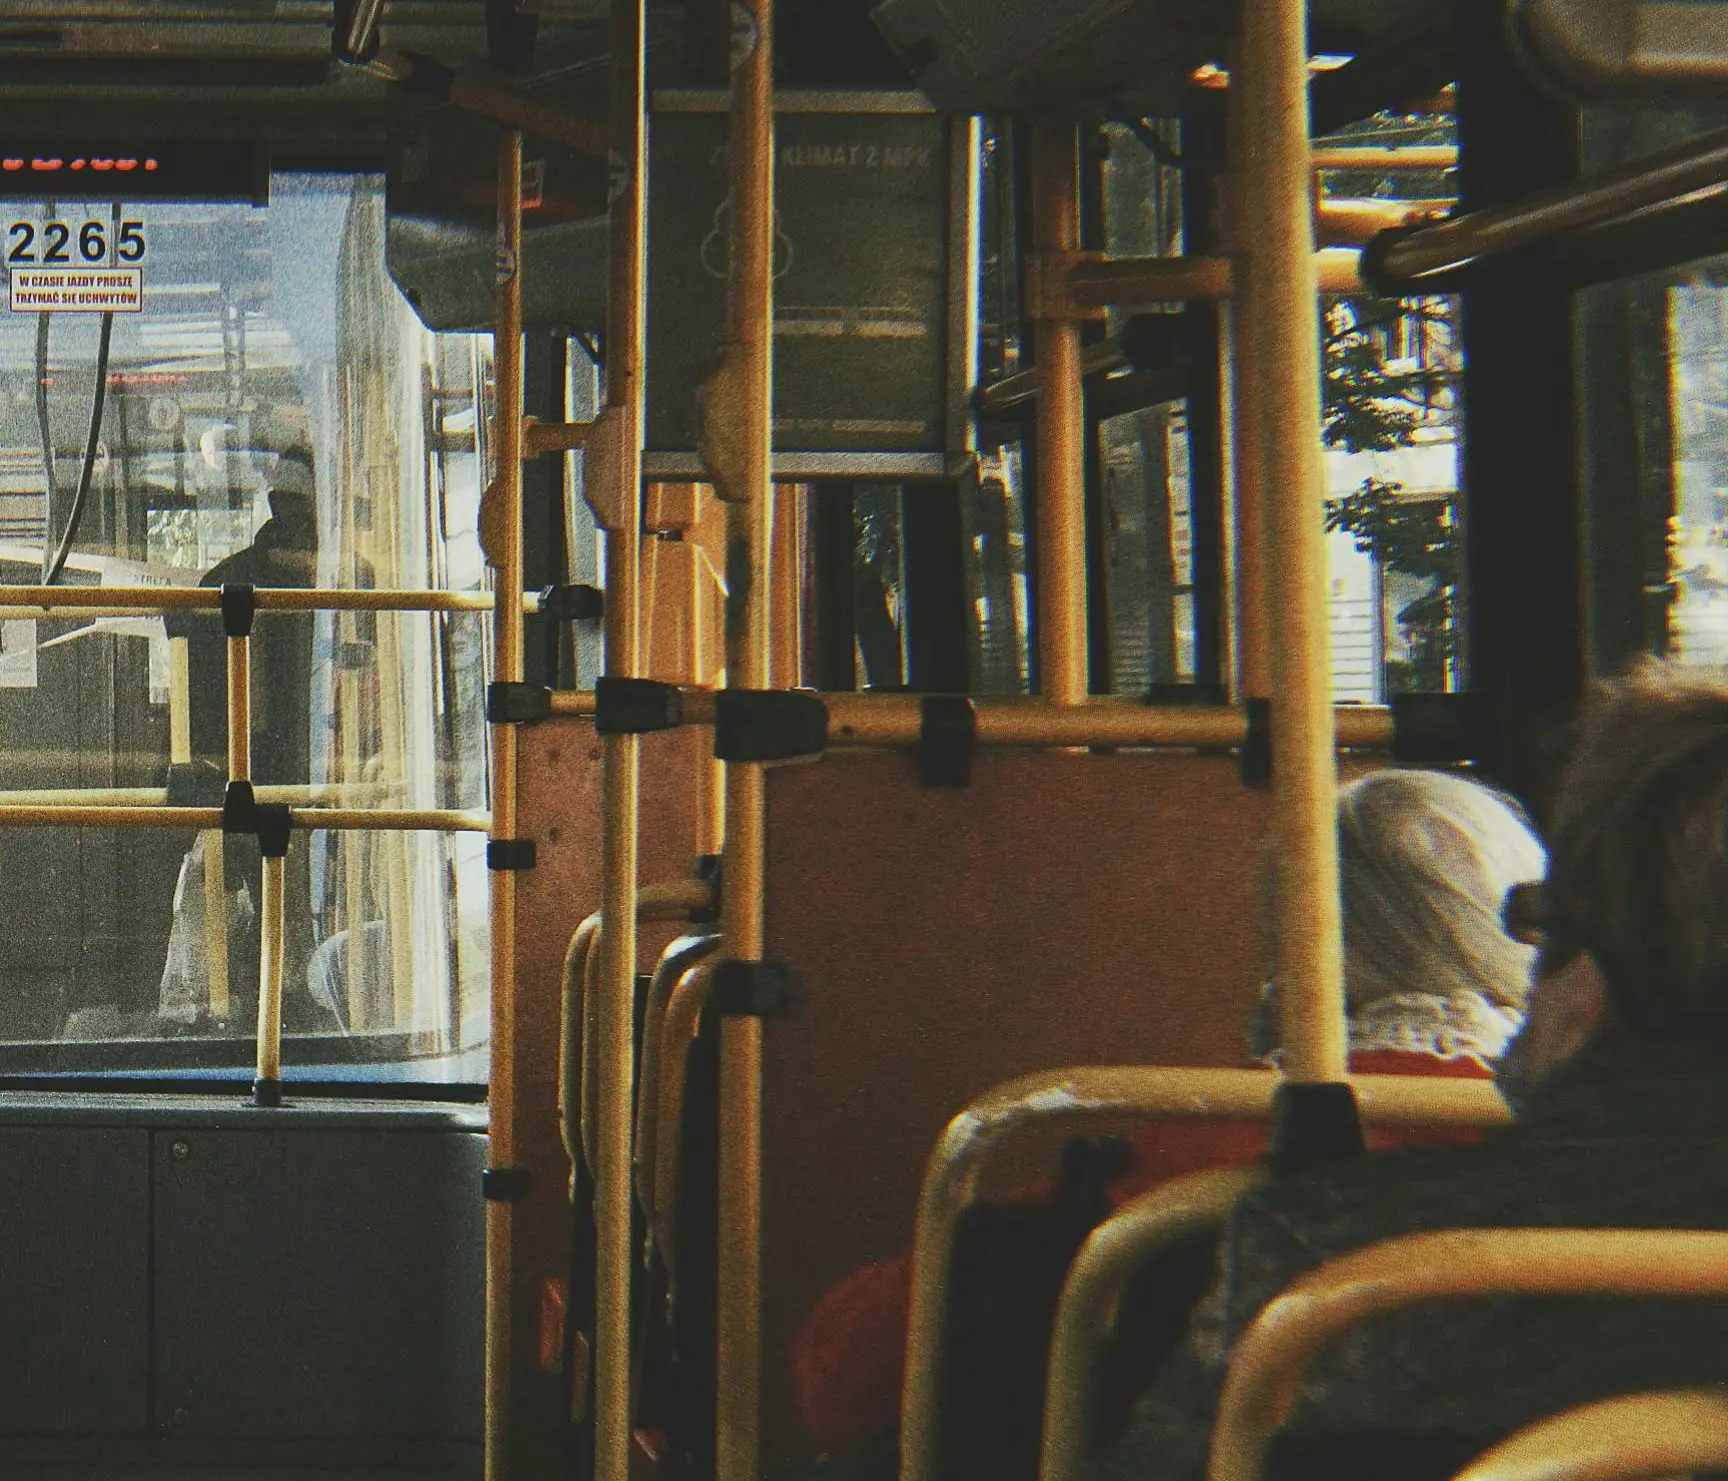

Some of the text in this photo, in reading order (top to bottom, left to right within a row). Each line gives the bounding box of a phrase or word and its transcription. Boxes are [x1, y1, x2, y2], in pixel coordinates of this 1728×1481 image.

[8, 220, 146, 263] 2265
[19, 276, 133, 289] W CZASIE JAZDY PROSZĘ
[15, 291, 137, 306] TRZYMAĆ SIĘ UCHWYTÓW
